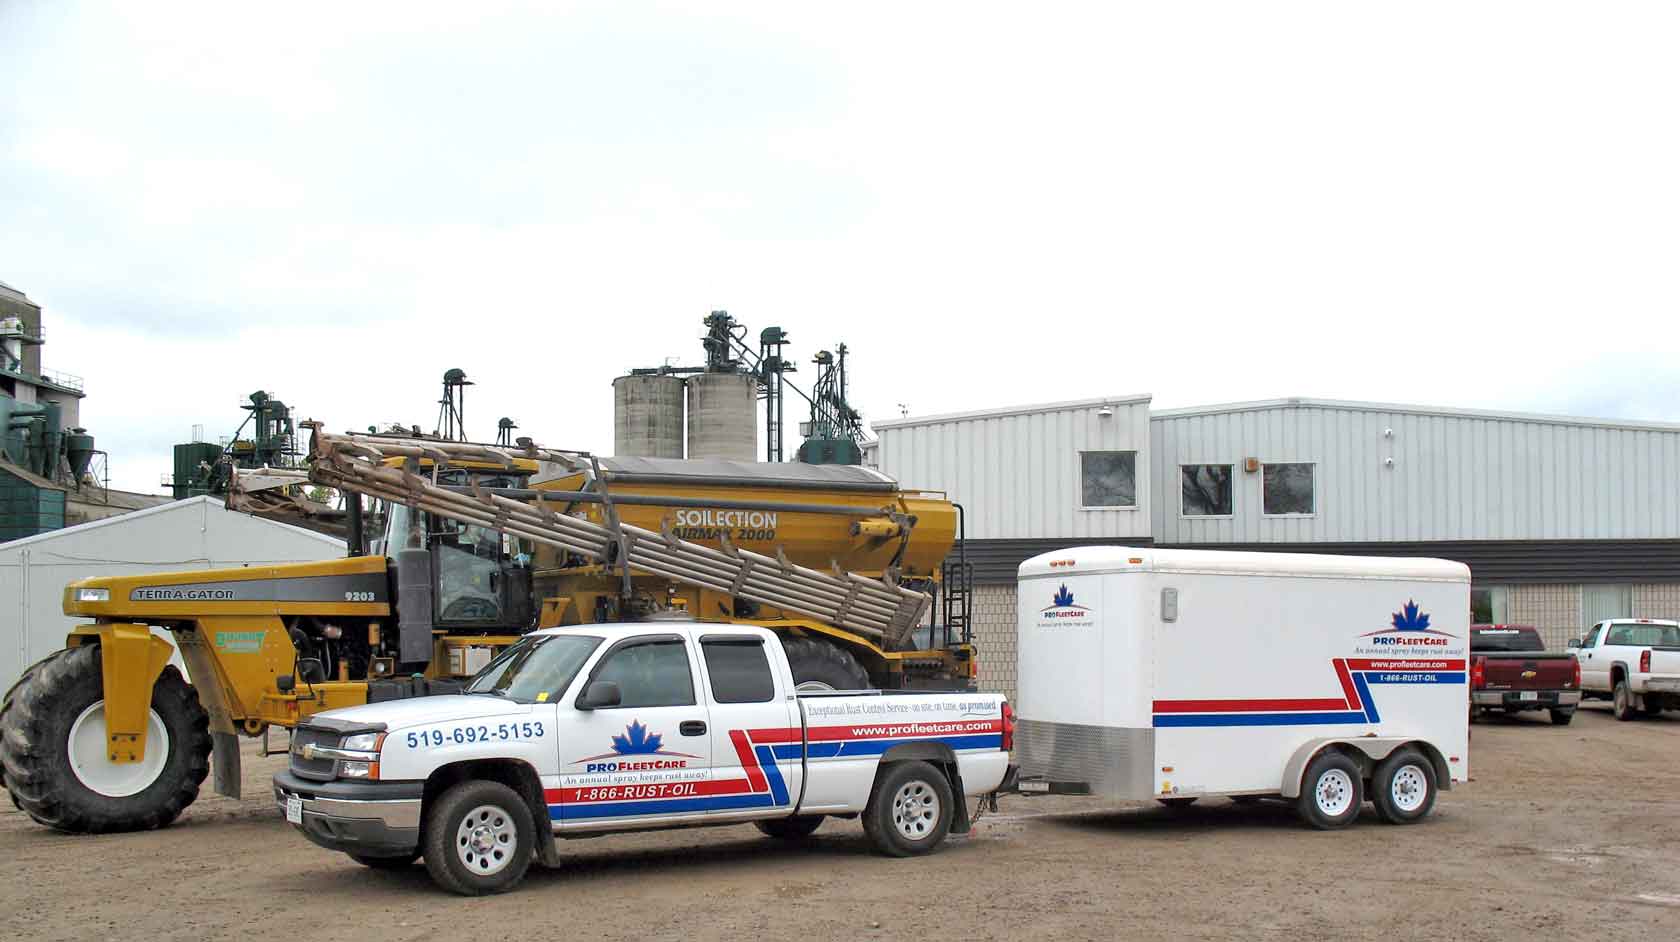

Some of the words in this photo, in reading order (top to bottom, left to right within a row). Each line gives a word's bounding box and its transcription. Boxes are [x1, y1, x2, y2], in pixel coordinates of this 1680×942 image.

[676, 510, 777, 528] SOILECTION
[738, 529, 775, 540] 2000
[344, 591, 375, 602] 9203
[1373, 637, 1448, 646] PROFLEETCARE
[1371, 660, 1447, 669] www.profleetcare.com
[1380, 674, 1437, 682] 1-866-RUST-OIL
[407, 721, 544, 748] 519-692-5153
[852, 722, 992, 736] www.profleetcare.com
[587, 760, 687, 773] PROFLEETCARE
[564, 776, 577, 785] An
[579, 774, 611, 785] annual
[613, 774, 637, 784] spray
[639, 772, 663, 783] keeps
[665, 772, 682, 780] rust
[684, 770, 708, 780] away!
[575, 783, 698, 801] 1-866-RUST-OIL
